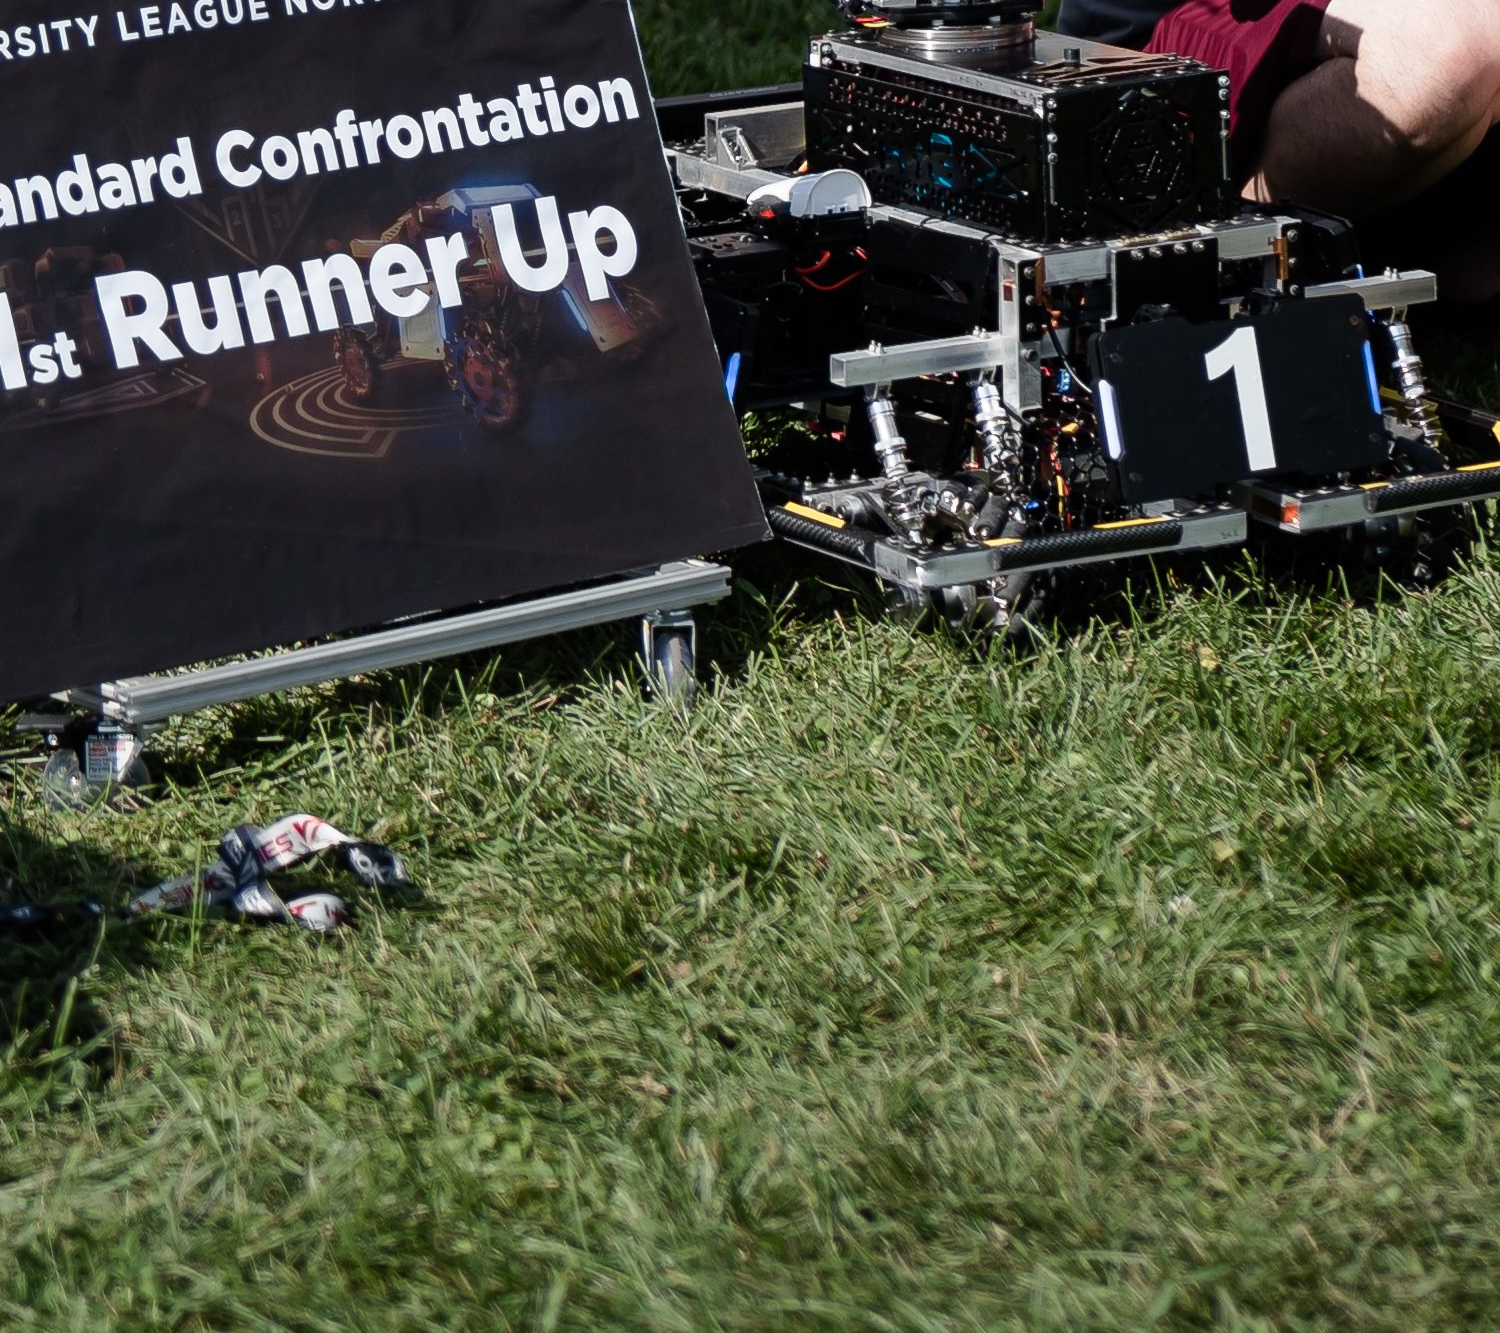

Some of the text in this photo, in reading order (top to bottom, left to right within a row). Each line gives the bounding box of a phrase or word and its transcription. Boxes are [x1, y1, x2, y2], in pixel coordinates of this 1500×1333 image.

[214, 76, 641, 188] Confrontation
[94, 232, 471, 370] Runner
[491, 194, 639, 303] Up
[1204, 325, 1277, 472] 1
